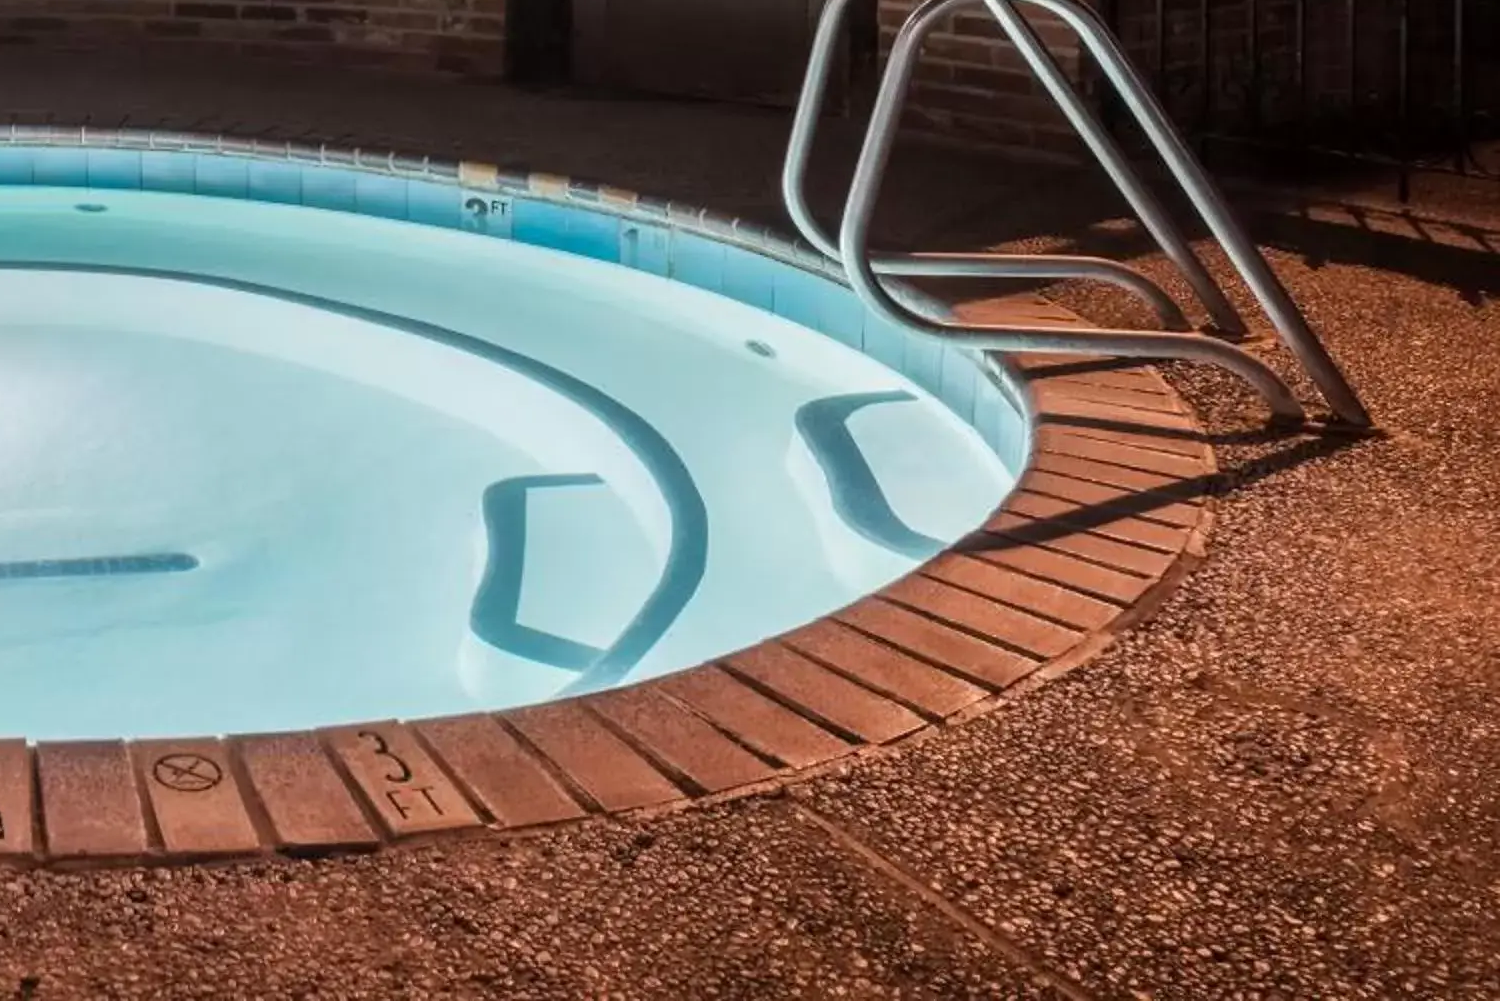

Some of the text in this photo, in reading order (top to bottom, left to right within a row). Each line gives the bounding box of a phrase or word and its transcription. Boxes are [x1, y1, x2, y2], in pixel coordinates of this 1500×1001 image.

[489, 200, 509, 216] FT
[358, 730, 412, 783] 3
[386, 786, 444, 820] FT
